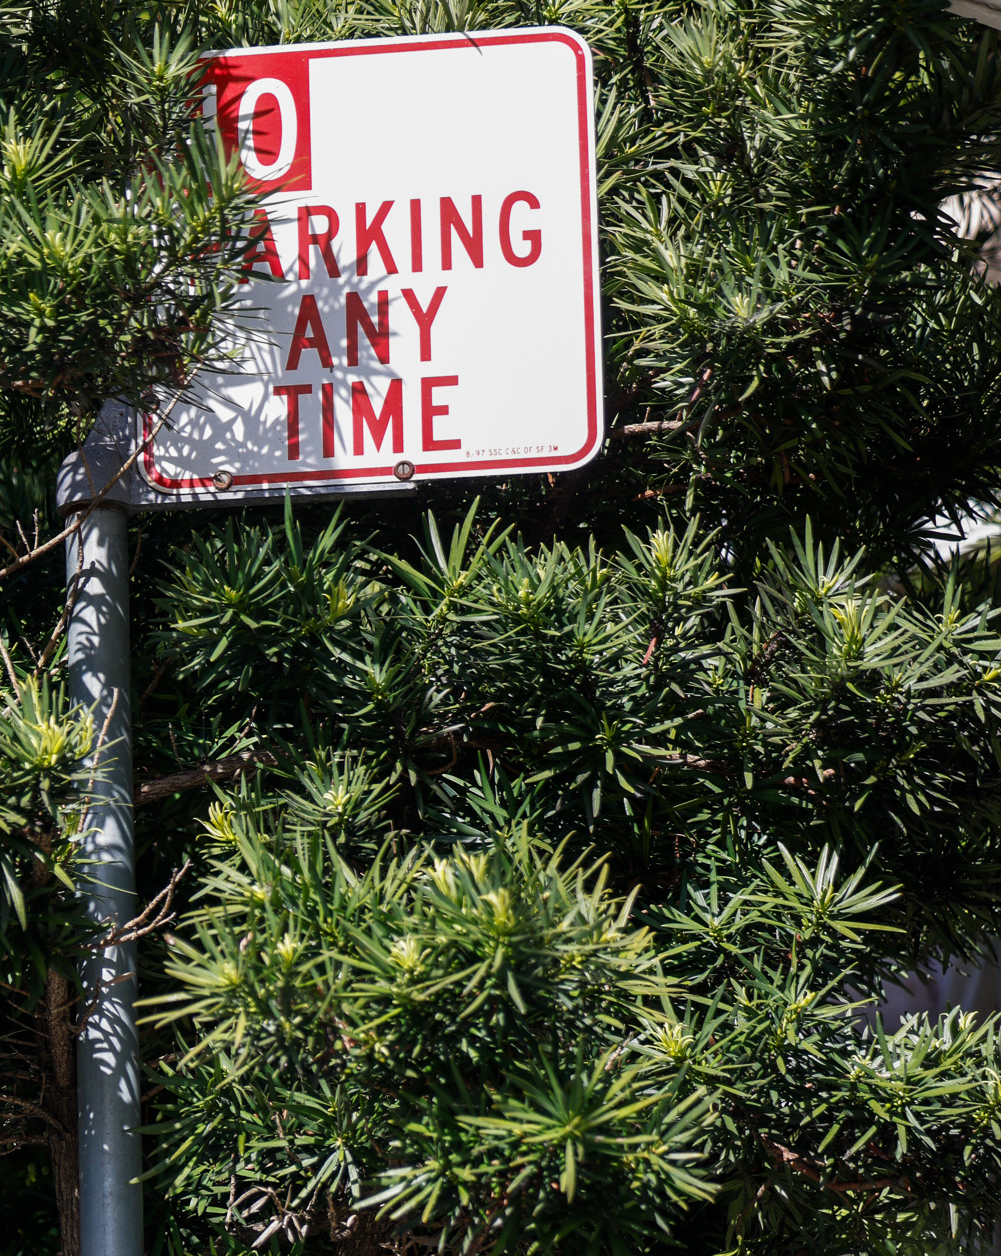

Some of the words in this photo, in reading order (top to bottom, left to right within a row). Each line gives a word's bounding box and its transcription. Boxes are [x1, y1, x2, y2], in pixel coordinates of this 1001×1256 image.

[190, 191, 543, 287] ARKING
[286, 286, 449, 371] ANY
[272, 375, 462, 461] TIME
[488, 448, 503, 456] SSC
[505, 447, 521, 455] C&C
[523, 446, 533, 454] OF
[535, 445, 545, 453] SF
[547, 445, 559, 453] 3M
